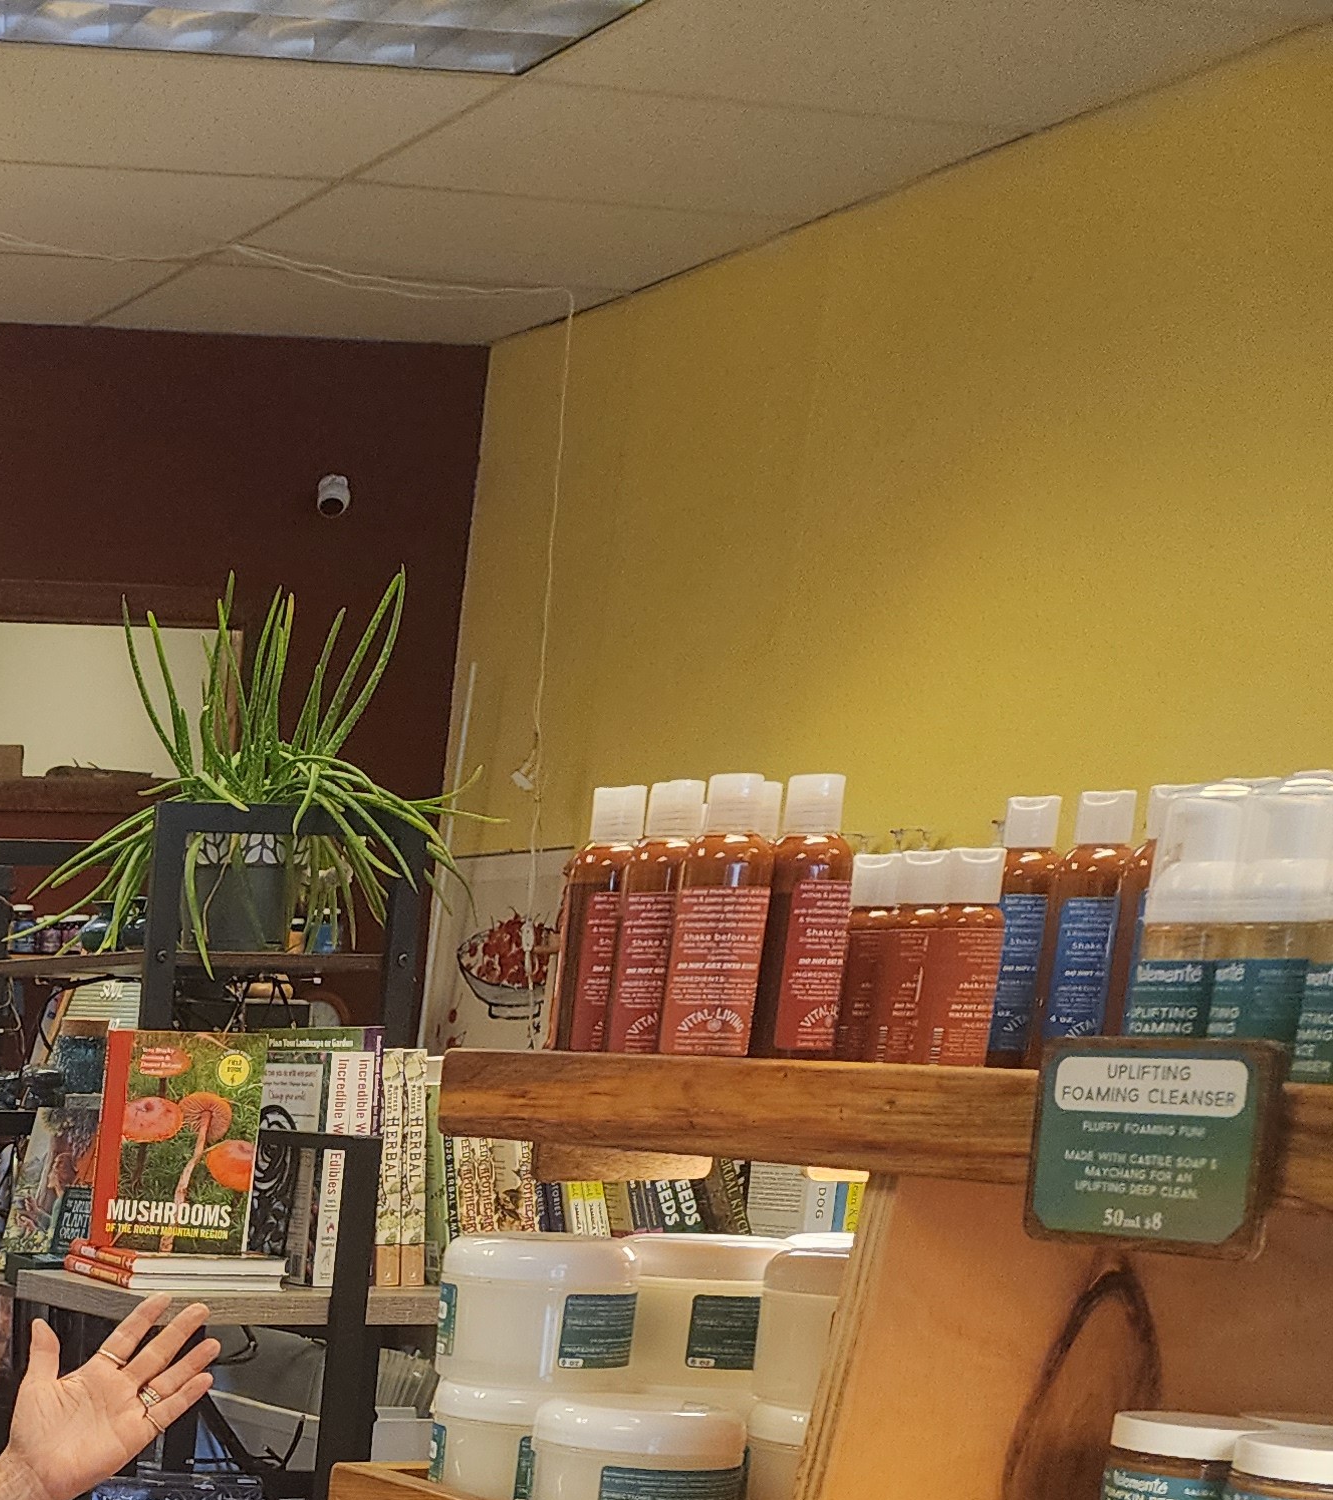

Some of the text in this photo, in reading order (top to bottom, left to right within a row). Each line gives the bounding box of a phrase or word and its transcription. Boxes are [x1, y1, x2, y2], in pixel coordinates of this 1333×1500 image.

[1106, 1063, 1191, 1082] UPLIFTING
[355, 1058, 370, 1119] Incredible
[1061, 1084, 1236, 1107] FOAMING CLEANSER
[327, 1058, 349, 1195] Incredible Edibles
[1081, 1121, 1176, 1136] FLUFFY FOAMING
[385, 1116, 400, 1183] HERBAL
[409, 1116, 424, 1183] HERBAL
[1064, 1149, 1094, 1161] MADE
[1098, 1151, 1126, 1163] WITH
[1129, 1153, 1173, 1166] CASTILE
[446, 1163, 457, 1207] HERBAL
[1074, 1179, 1156, 1196] UPLIFTING DEEP
[1149, 1169, 1172, 1182] FOR
[1176, 1171, 1193, 1183] AN
[107, 1198, 232, 1228] MUSHROOMS
[815, 1186, 827, 1220] DOG
[106, 1222, 229, 1240] OF THE ROCKY MOUNTAIN REGION
